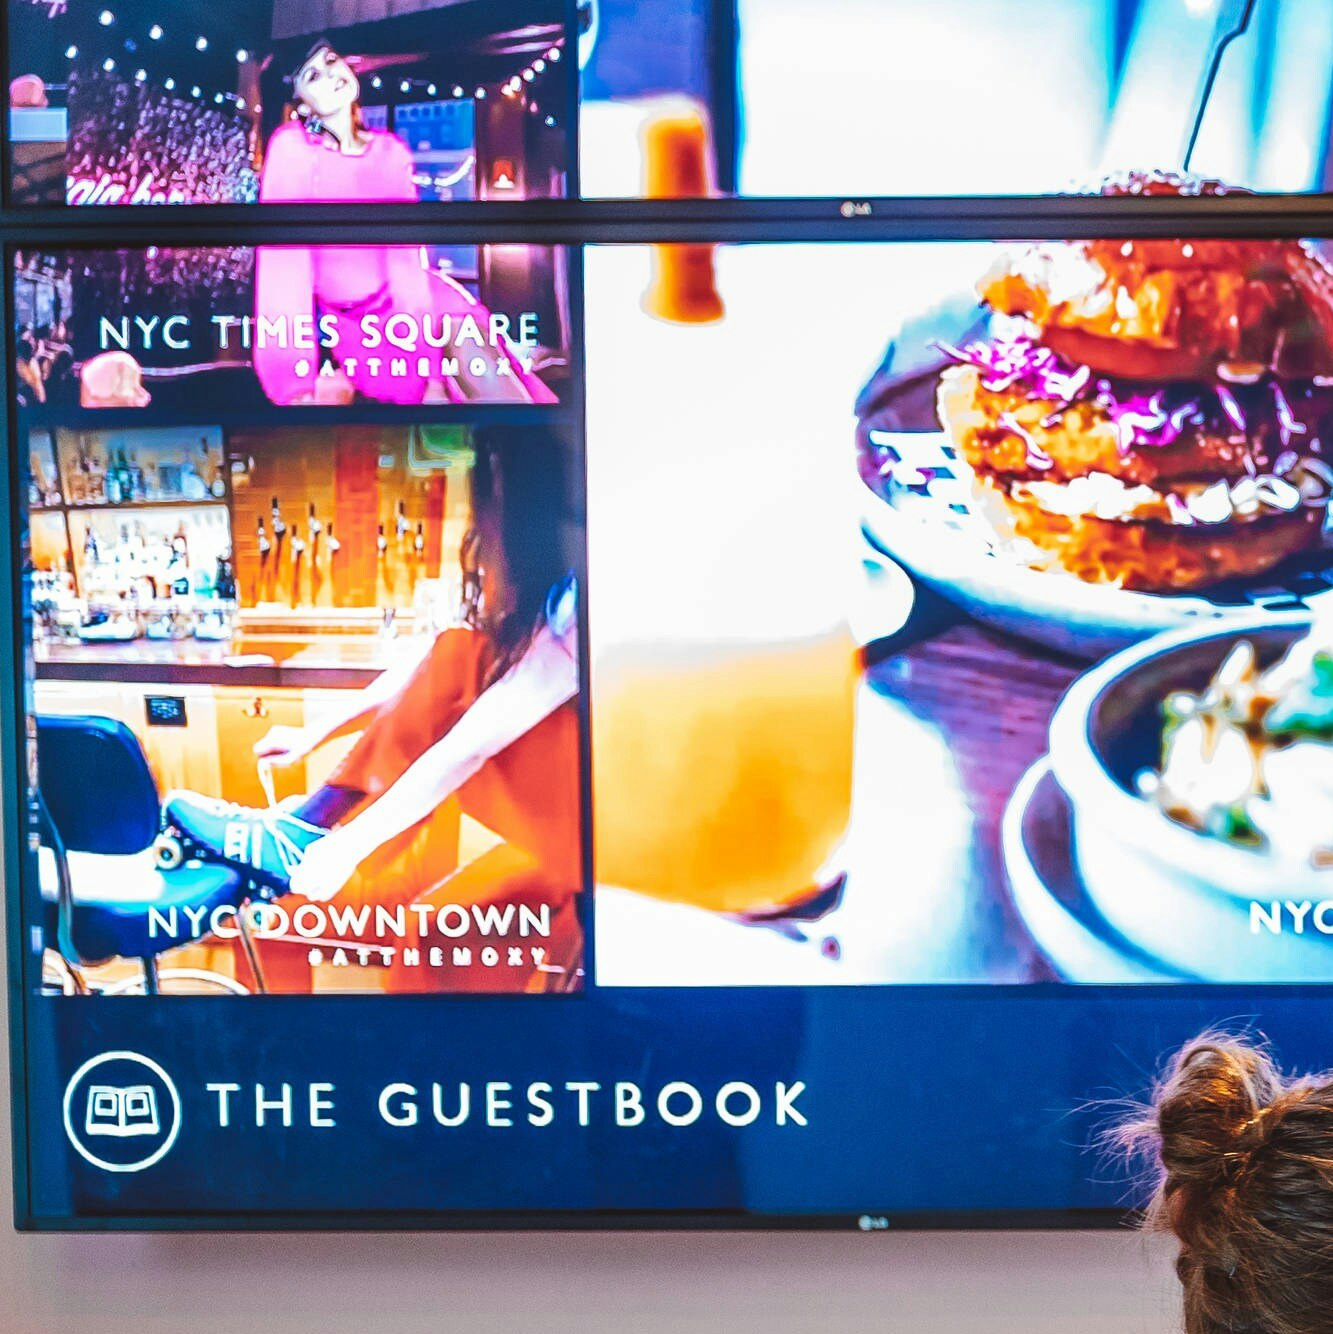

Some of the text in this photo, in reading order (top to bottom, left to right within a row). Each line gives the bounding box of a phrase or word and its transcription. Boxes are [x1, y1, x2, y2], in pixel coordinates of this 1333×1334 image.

[100, 313, 539, 352] NYC TIMES SQUARE
[147, 903, 551, 939] NYC DOWNTOWN
[206, 1081, 809, 1127] THE GUESTBOOK
